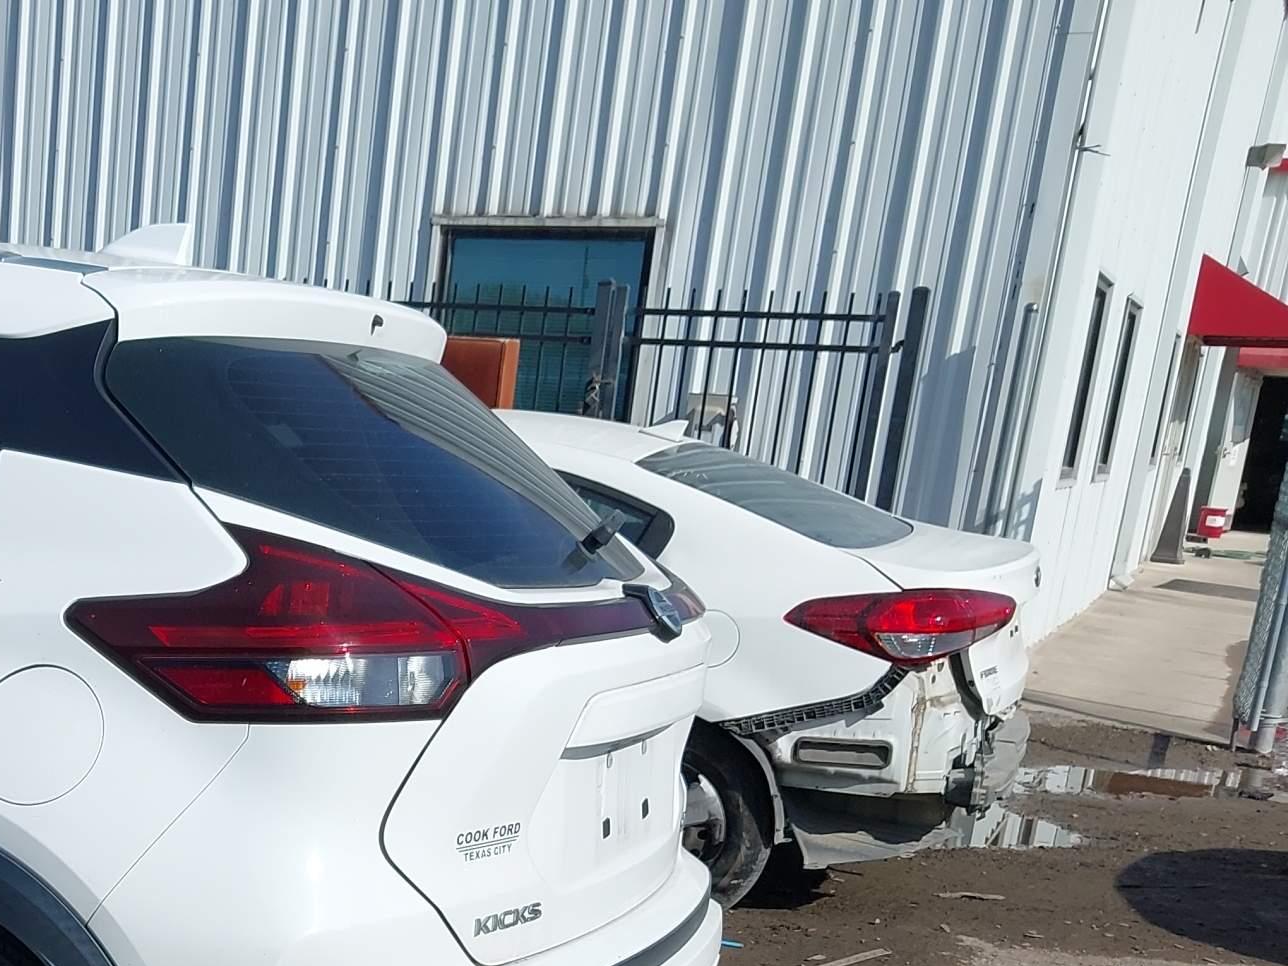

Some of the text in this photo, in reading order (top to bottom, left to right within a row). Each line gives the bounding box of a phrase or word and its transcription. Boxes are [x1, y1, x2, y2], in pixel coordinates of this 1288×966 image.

[456, 822, 521, 846] COOK FORD
[464, 843, 513, 862] TEXAS CITY
[473, 902, 542, 937] KICKS
